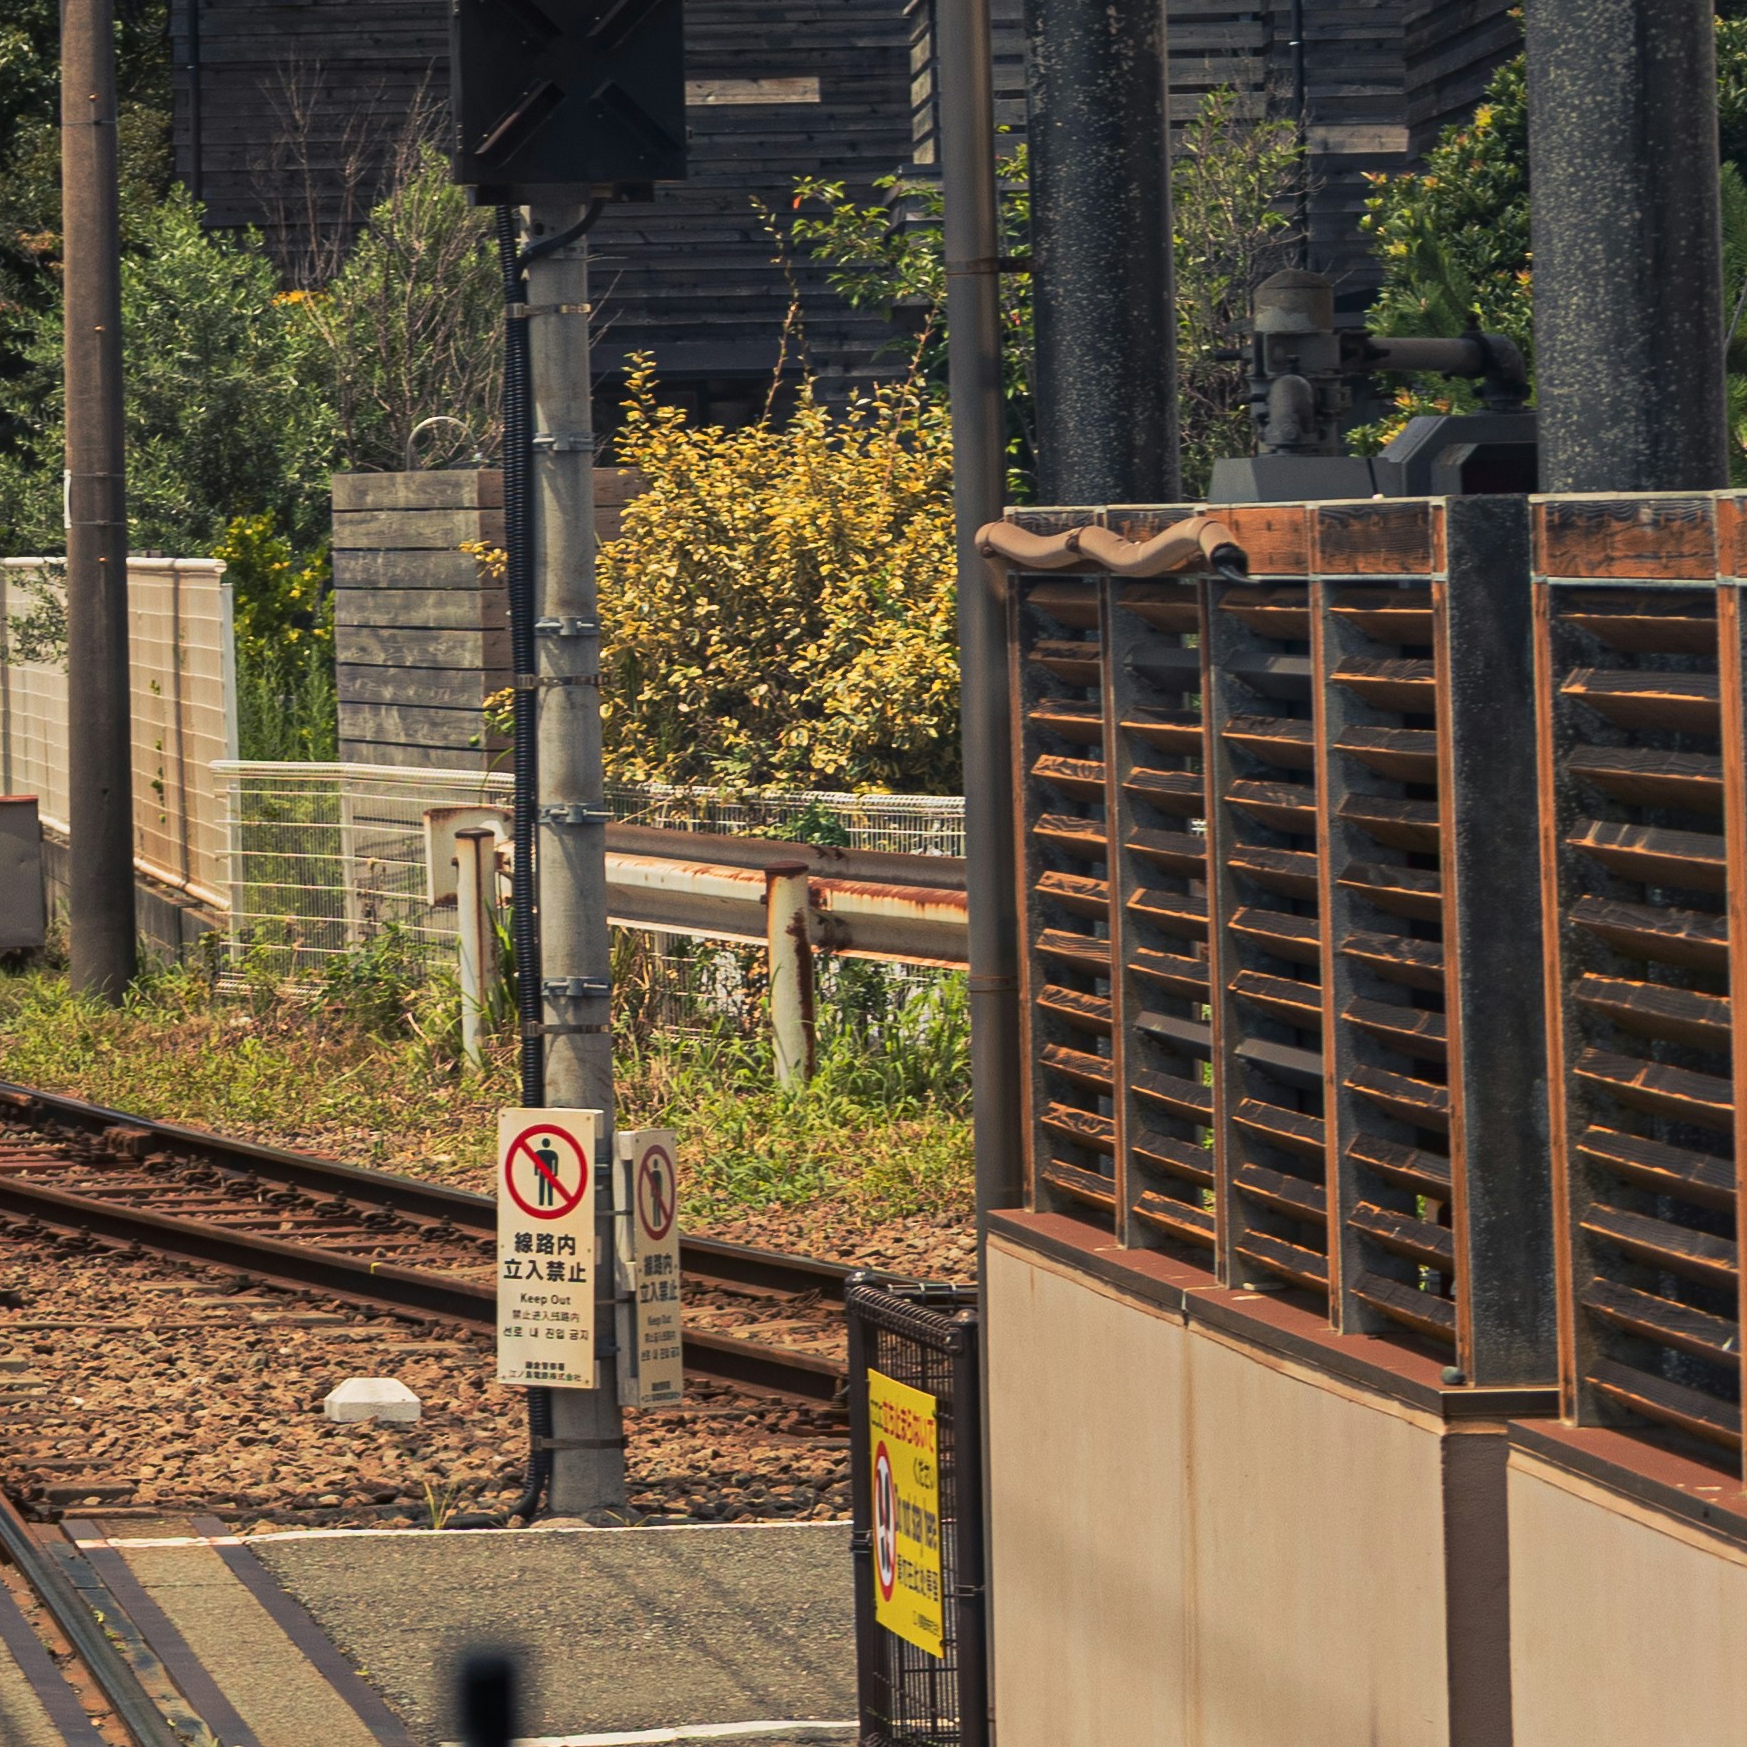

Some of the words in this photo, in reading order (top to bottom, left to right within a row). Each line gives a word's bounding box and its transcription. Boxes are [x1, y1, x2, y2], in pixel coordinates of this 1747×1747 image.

[514, 1232, 576, 1255] 線路内
[503, 1258, 587, 1283] 立入禁止
[520, 1292, 547, 1306] Keep
[550, 1294, 571, 1305] Out
